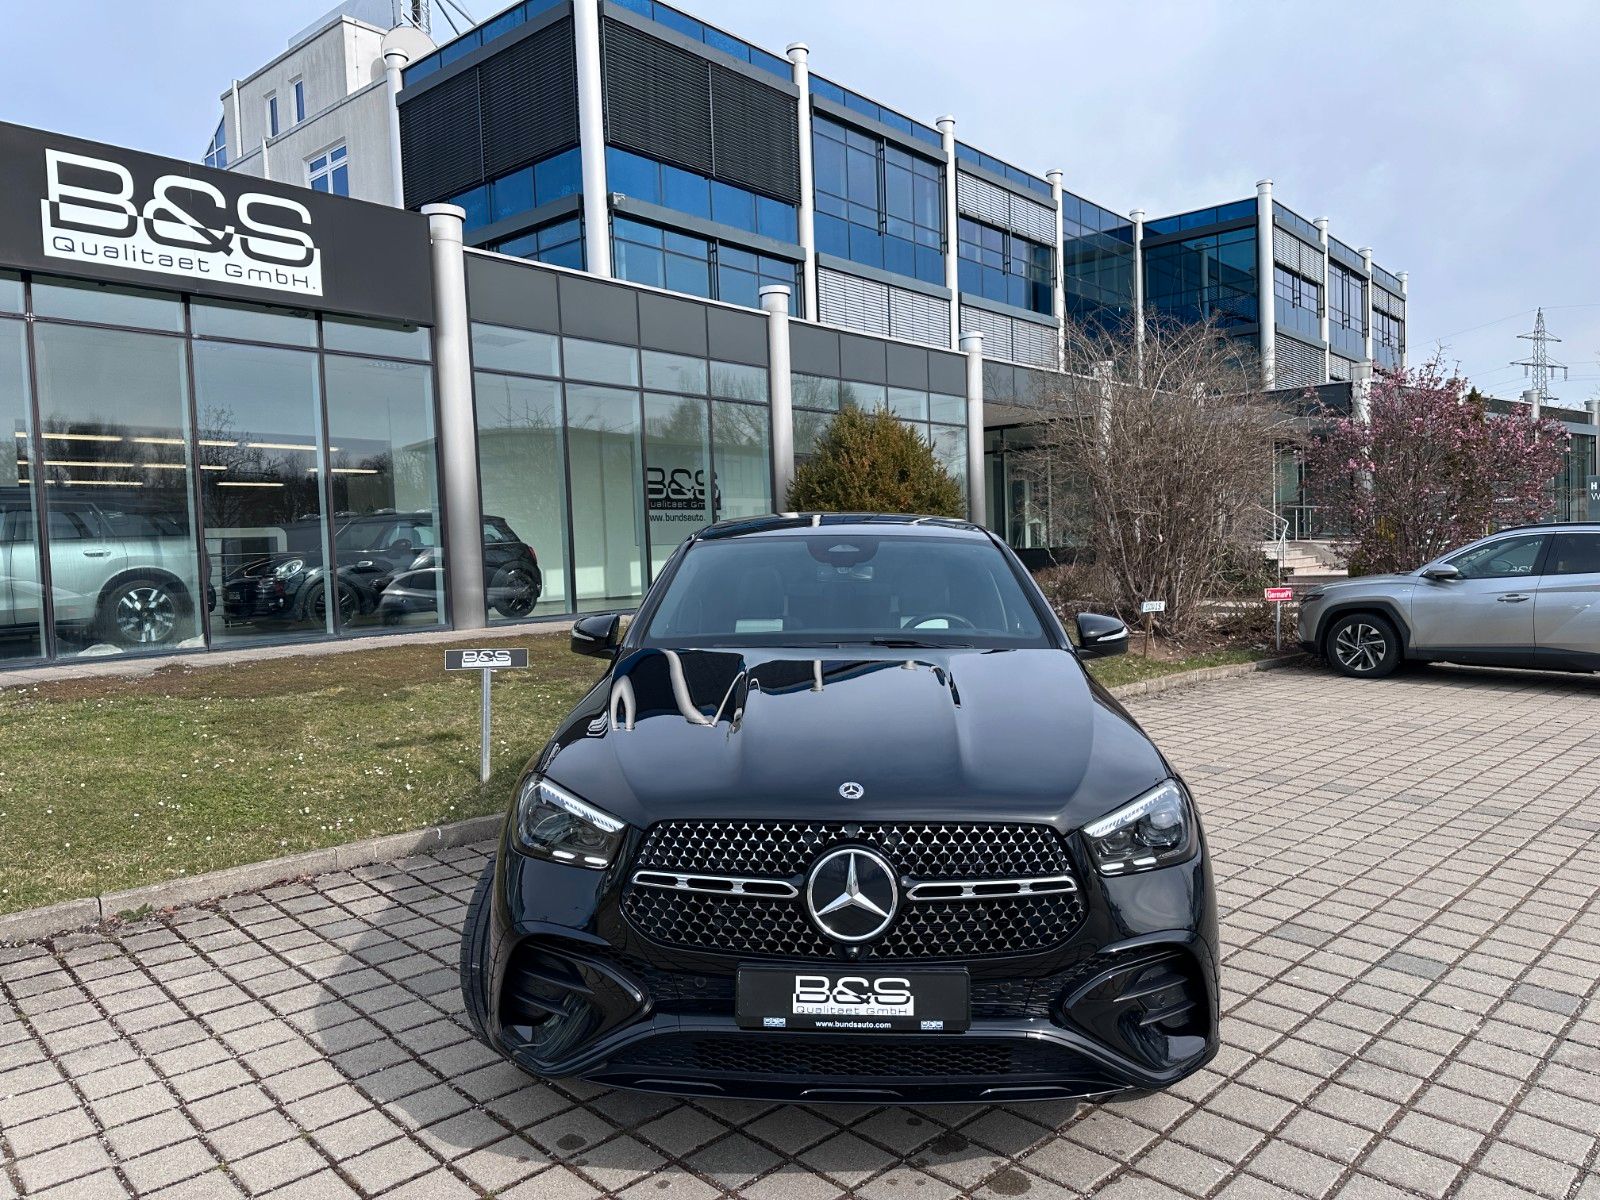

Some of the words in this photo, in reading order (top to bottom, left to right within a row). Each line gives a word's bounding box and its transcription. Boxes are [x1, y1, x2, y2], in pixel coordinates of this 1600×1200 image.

[45, 148, 314, 267] B&S
[52, 235, 211, 274] Qualitaet
[650, 500, 687, 508] ualitaet
[463, 651, 511, 662] B&S
[795, 975, 911, 1005] B&S
[796, 1005, 860, 1014] Qualitaet
[815, 1020, 892, 1029] www.bundsauto.com
